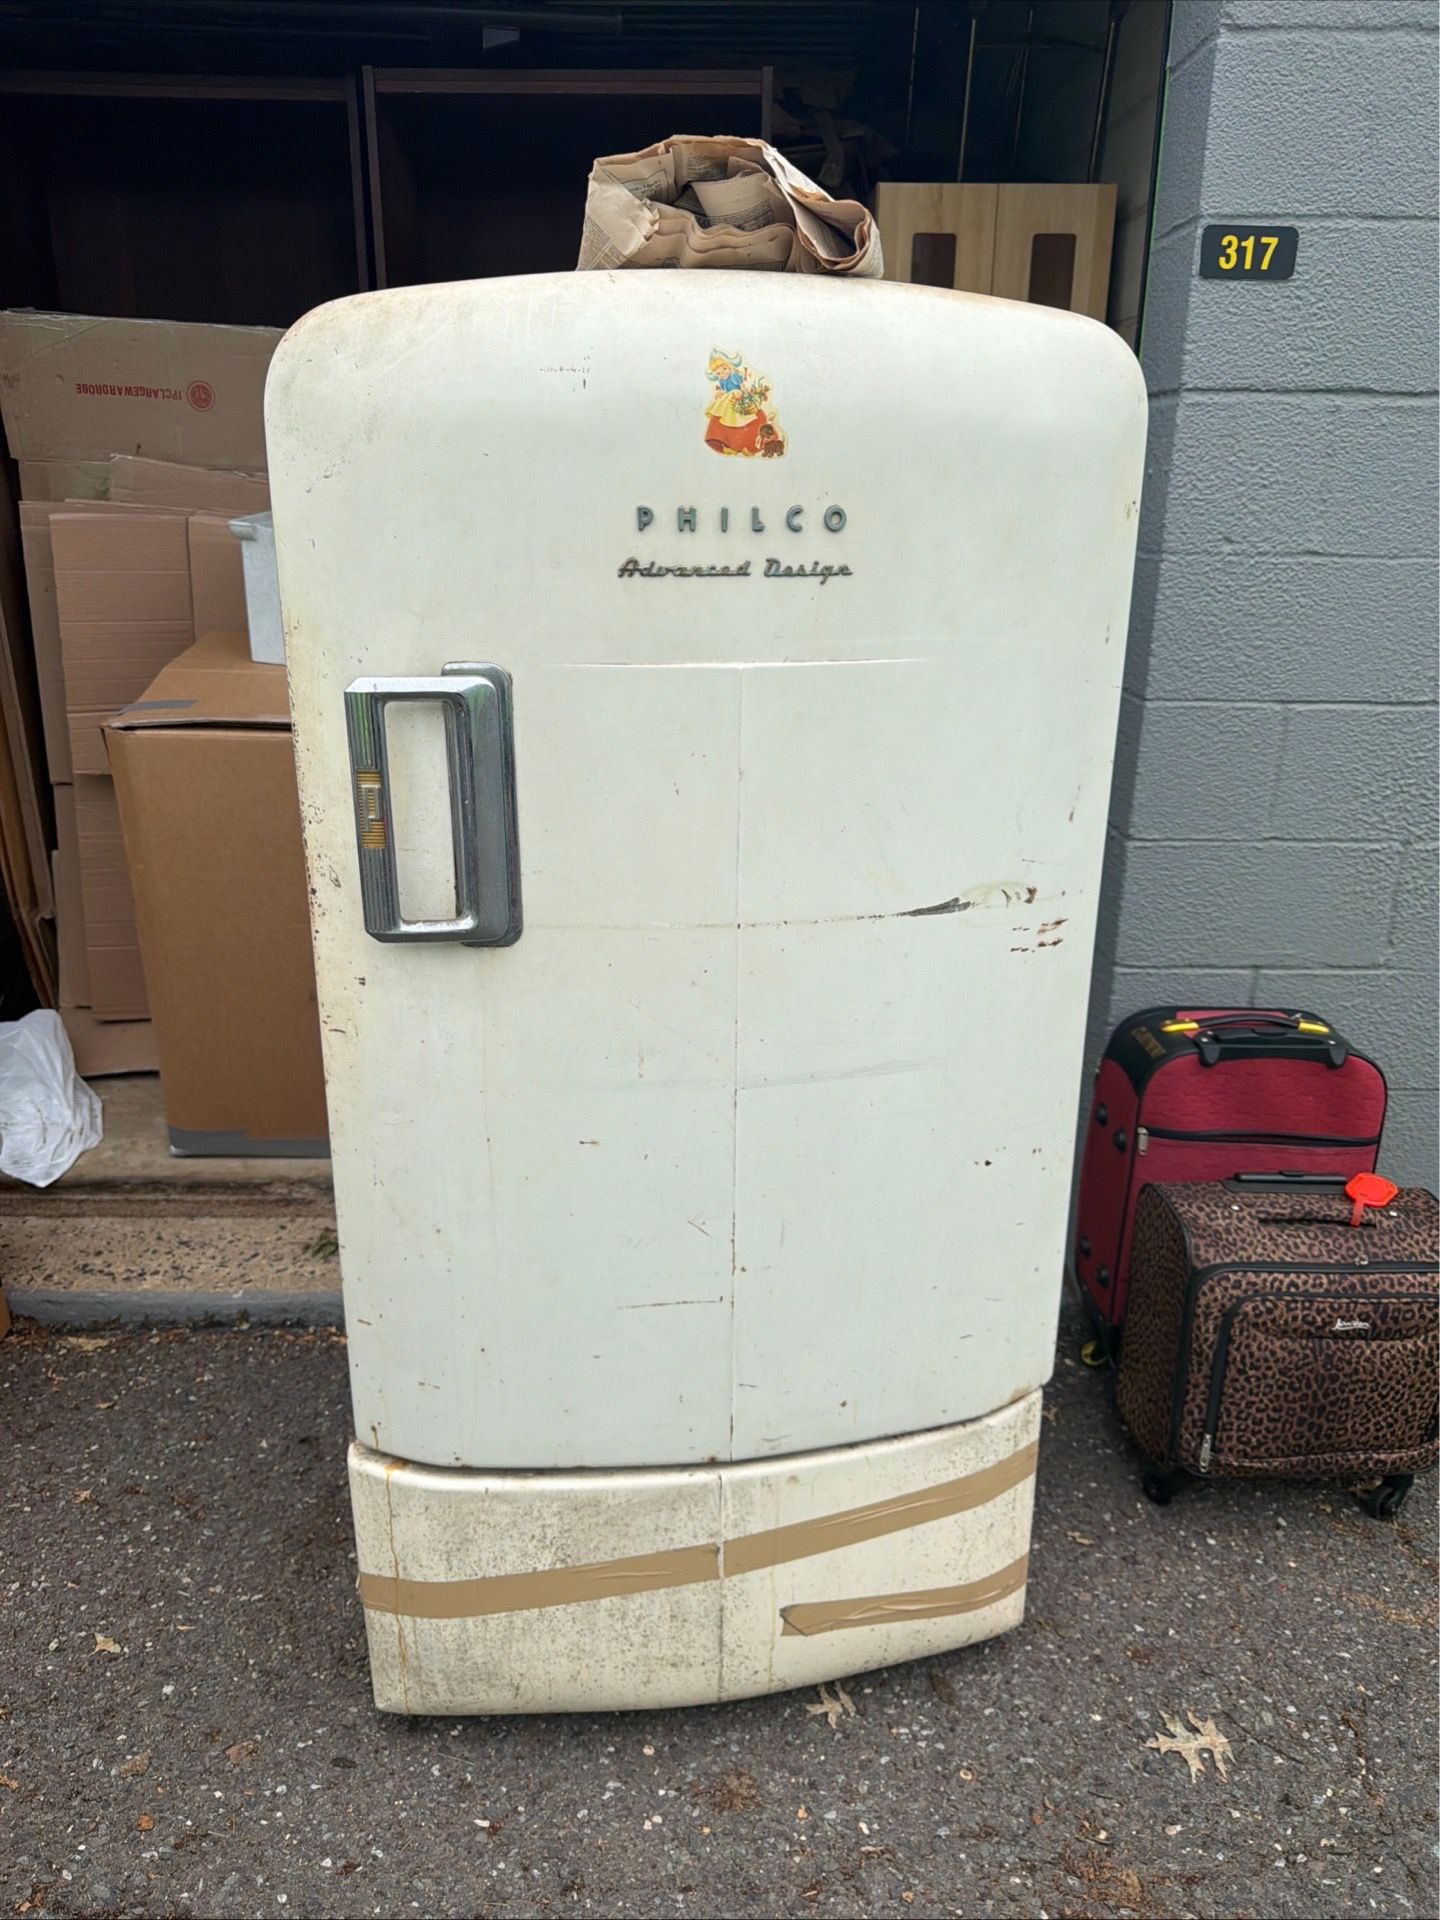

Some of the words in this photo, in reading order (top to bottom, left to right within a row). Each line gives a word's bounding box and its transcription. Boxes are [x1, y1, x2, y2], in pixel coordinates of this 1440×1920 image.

[1218, 234, 1279, 270] 317
[636, 505, 847, 532] PHILCO
[617, 556, 751, 577] Advanced
[763, 557, 853, 585] Design
